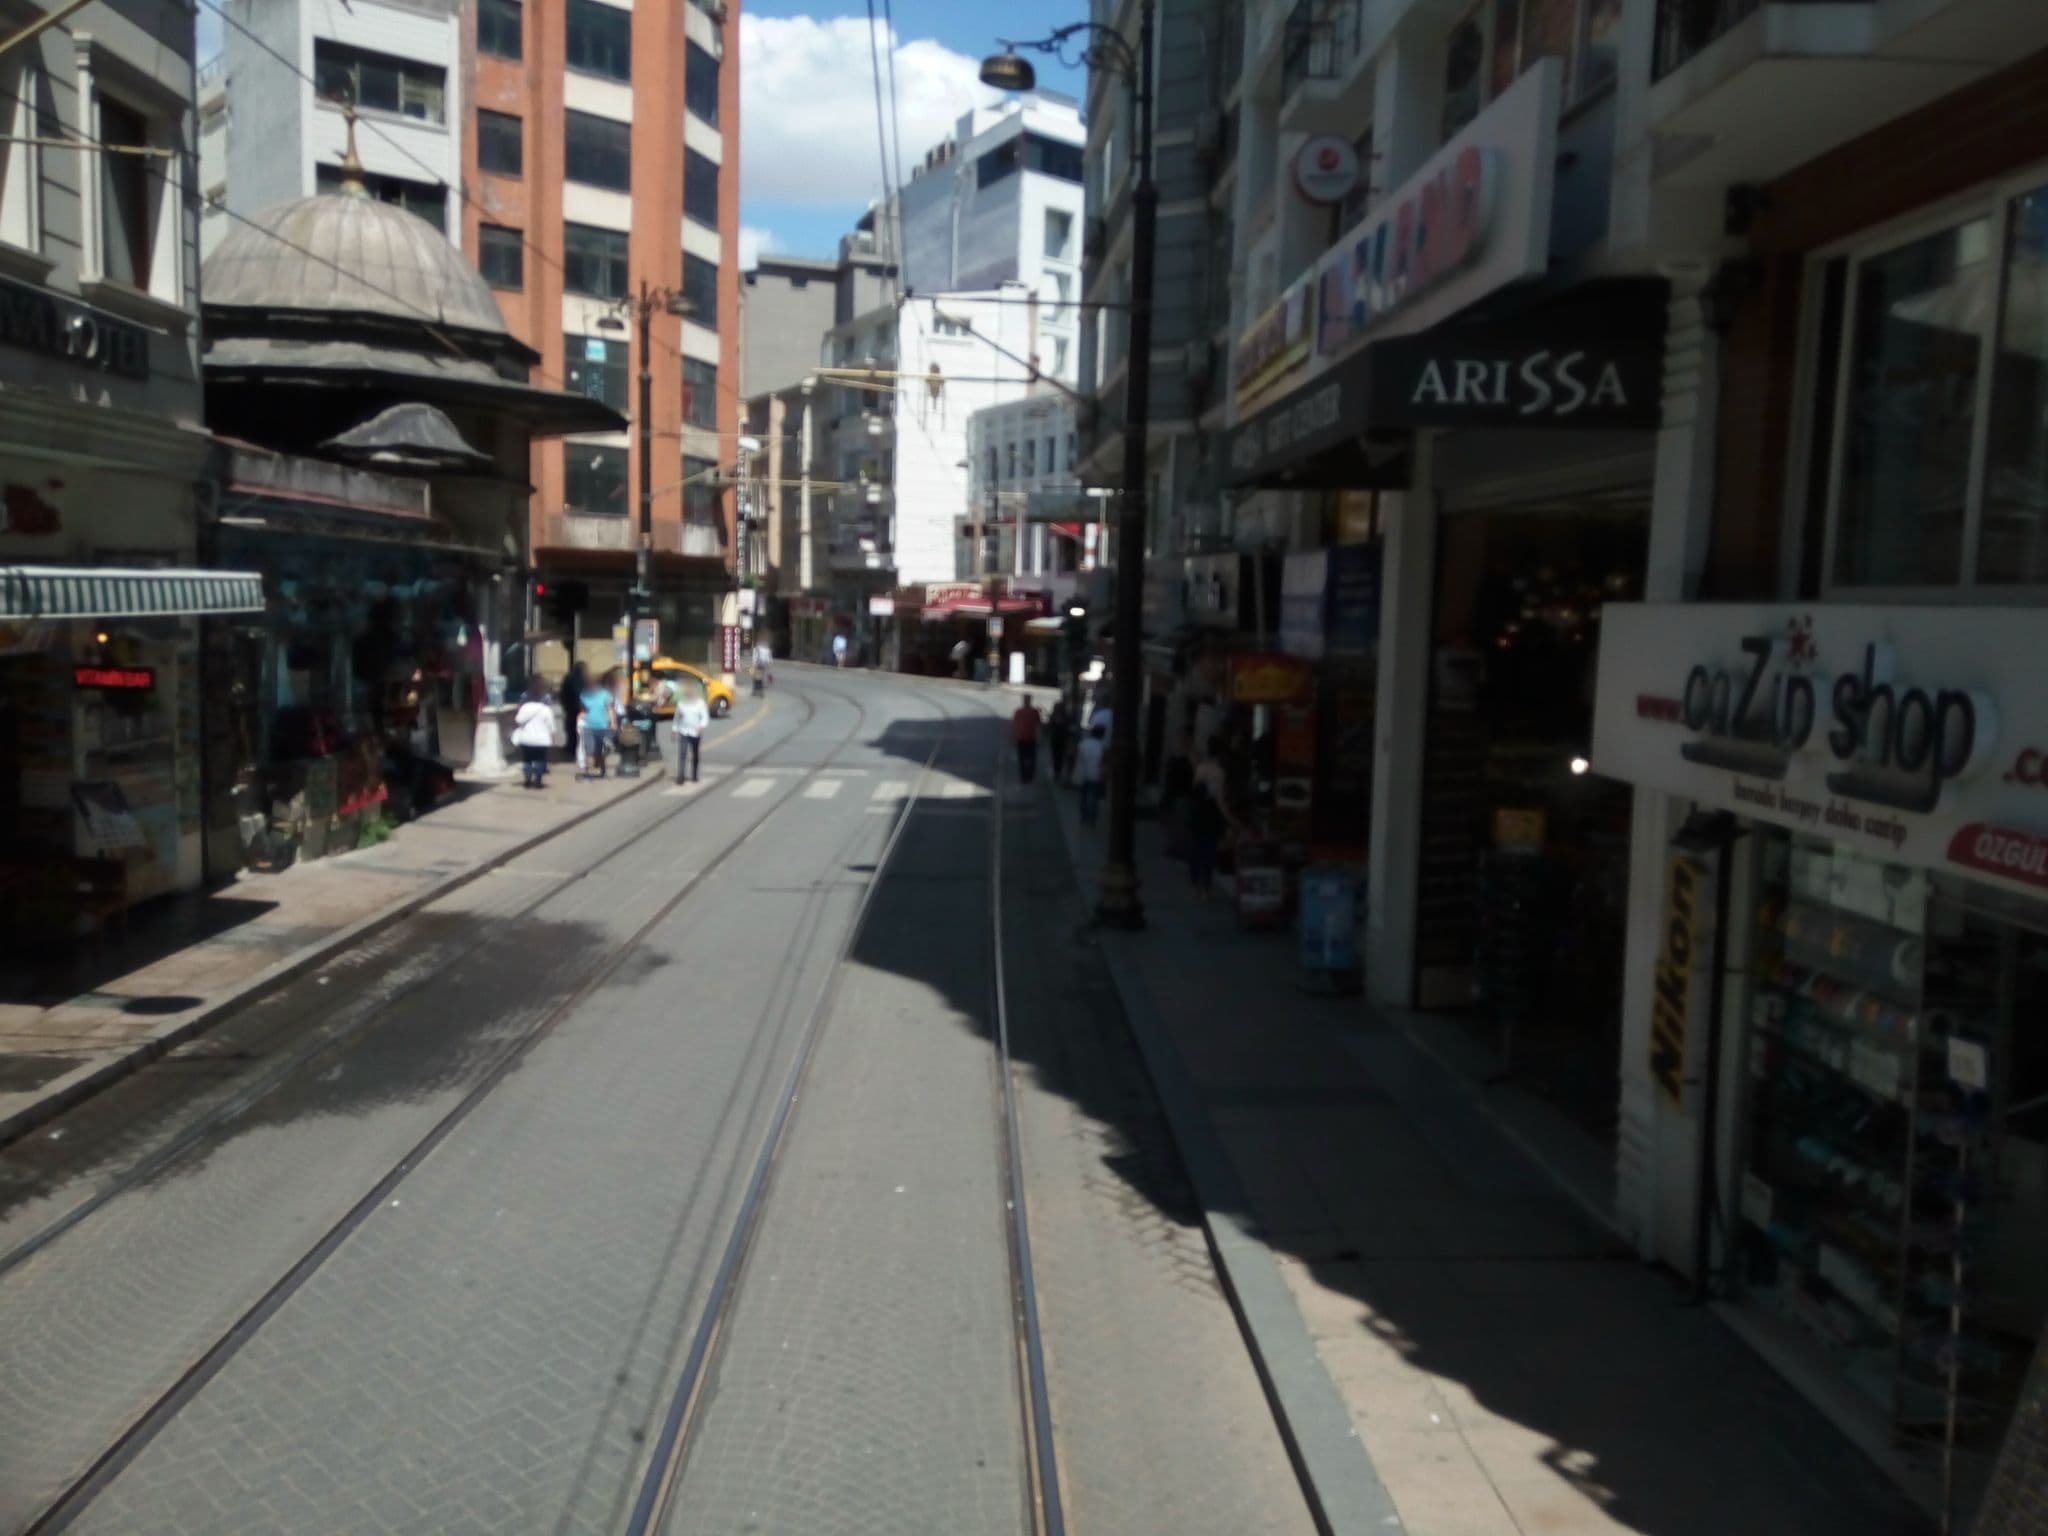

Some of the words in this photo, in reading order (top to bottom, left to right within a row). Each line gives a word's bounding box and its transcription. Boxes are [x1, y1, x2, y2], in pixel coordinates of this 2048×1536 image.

[1411, 350, 1627, 416] ARISSA
[1828, 641, 1978, 779] shop
[1651, 857, 1701, 1101] Nikon
